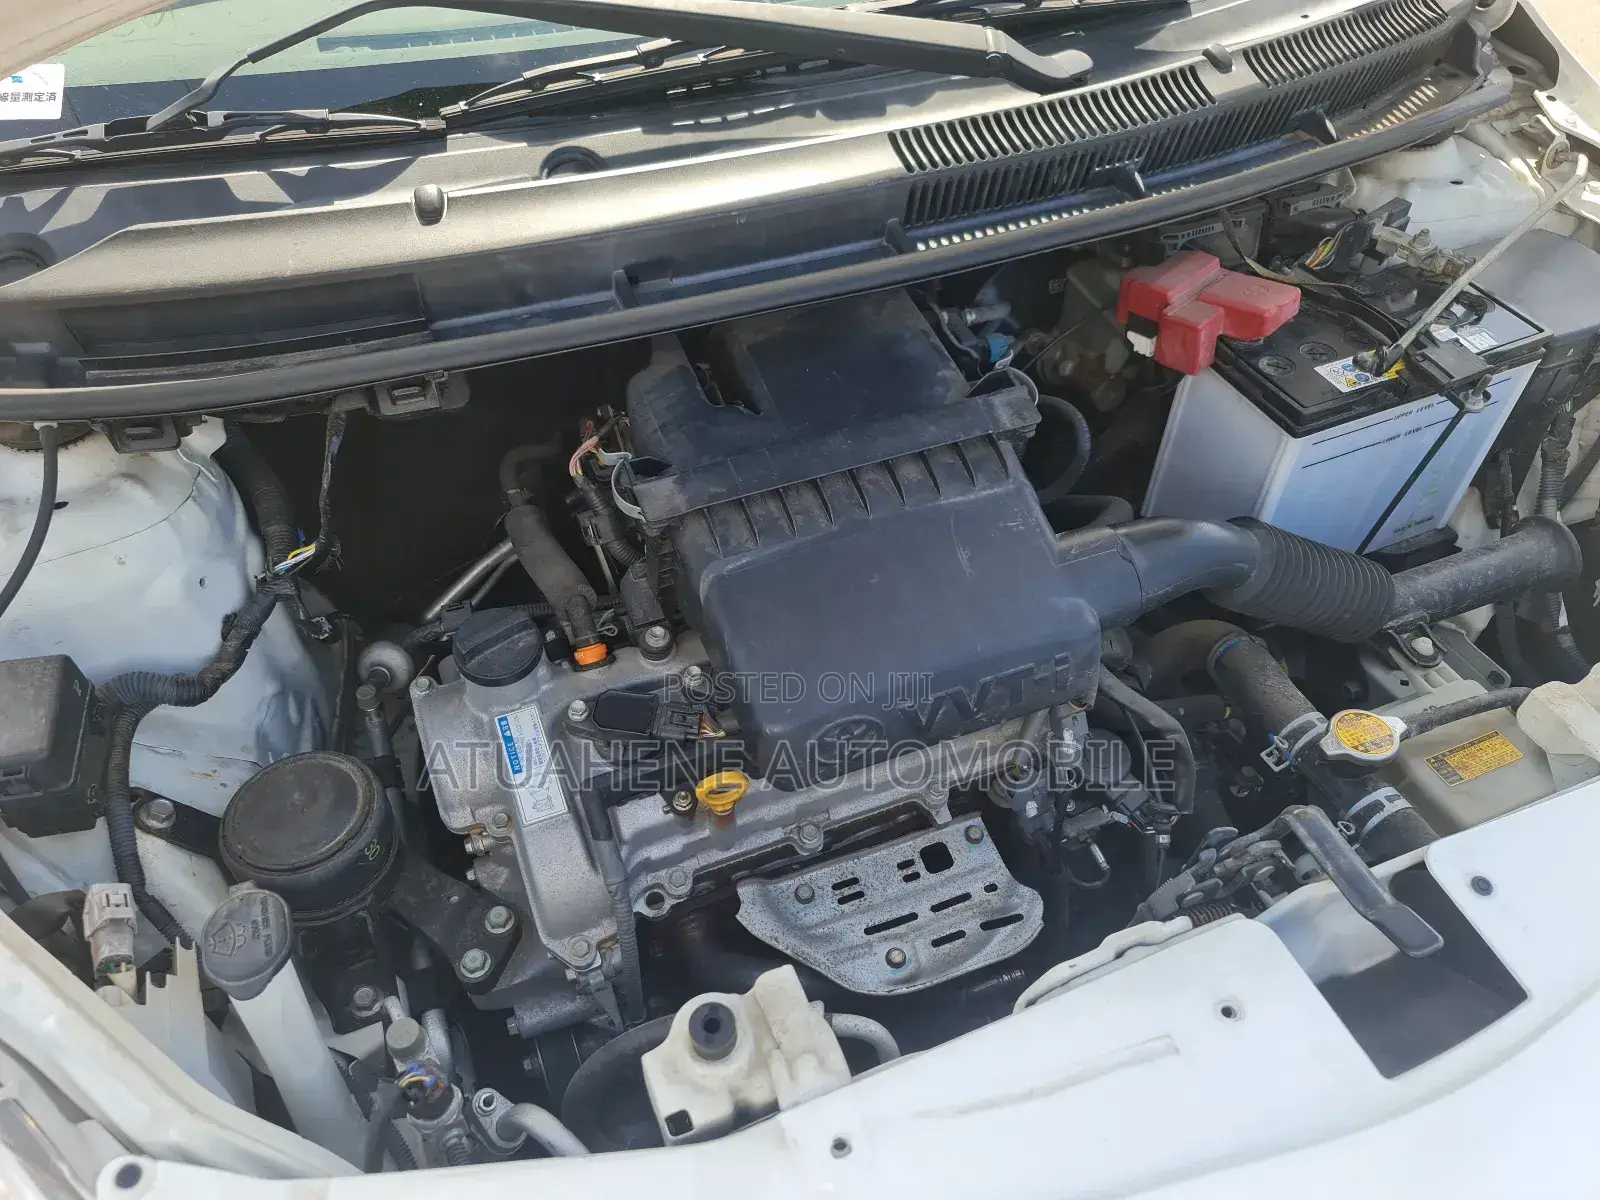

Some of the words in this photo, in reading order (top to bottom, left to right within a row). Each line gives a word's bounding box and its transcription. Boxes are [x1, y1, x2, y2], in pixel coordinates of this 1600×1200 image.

[1416, 403, 1435, 412] LEVEL
[1404, 426, 1423, 435] LEVEL
[507, 742, 520, 770] NOTICE
